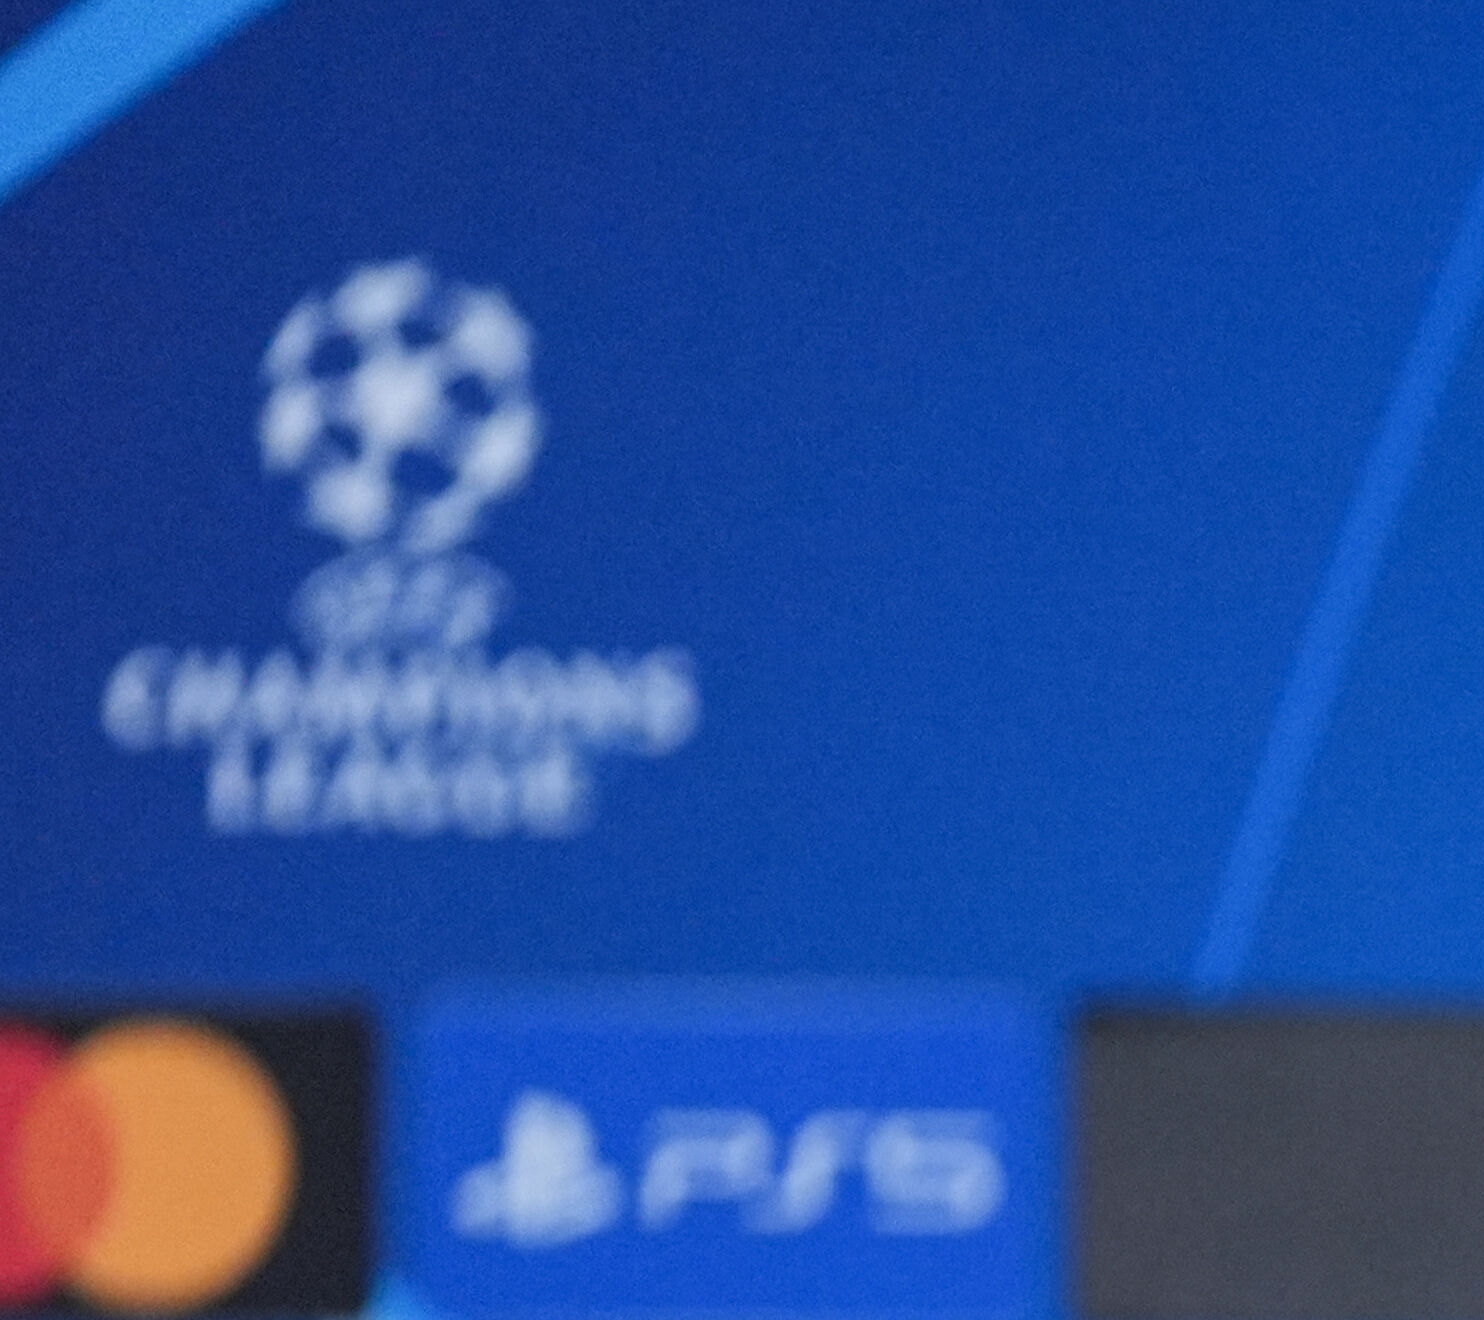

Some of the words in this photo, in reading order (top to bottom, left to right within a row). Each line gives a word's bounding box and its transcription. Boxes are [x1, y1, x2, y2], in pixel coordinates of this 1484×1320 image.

[102, 646, 701, 755] CHAMPIONS
[208, 735, 587, 838] LEAGUE
[637, 1108, 1003, 1234] PS5
